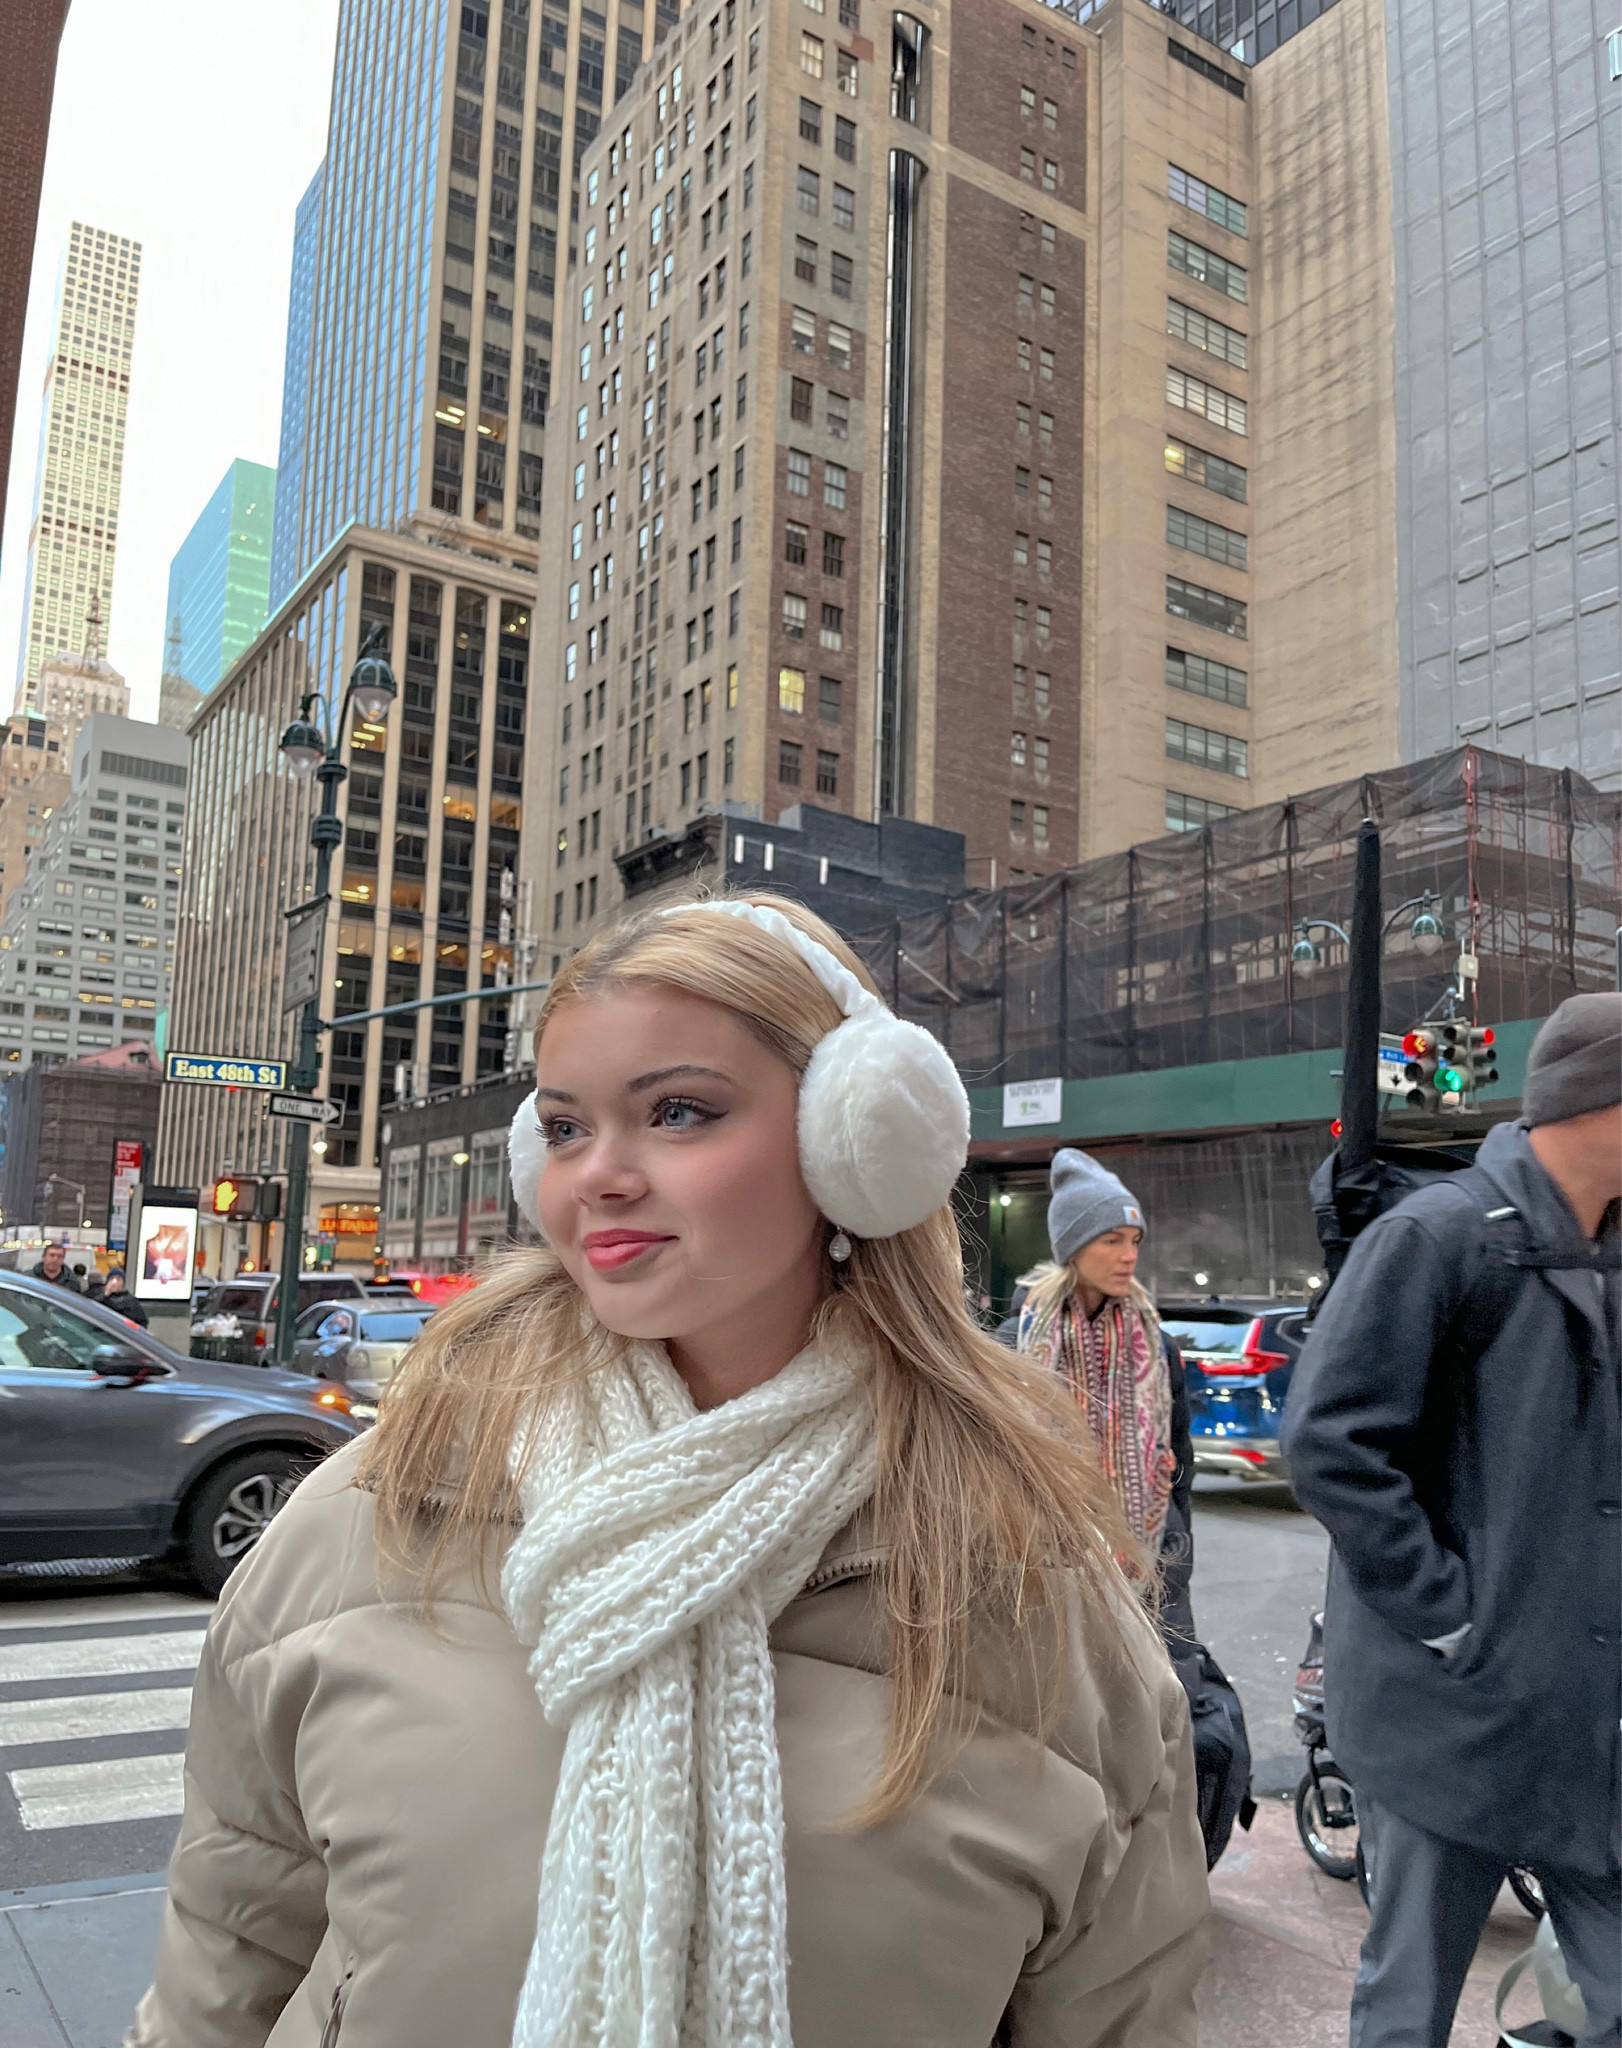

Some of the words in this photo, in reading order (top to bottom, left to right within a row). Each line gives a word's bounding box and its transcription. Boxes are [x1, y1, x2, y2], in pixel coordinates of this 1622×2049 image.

[176, 1059, 214, 1079] East
[217, 1063, 255, 1083] 48th
[258, 1066, 278, 1084] St
[280, 1102, 300, 1113] ONE
[311, 1106, 332, 1118] WAY
